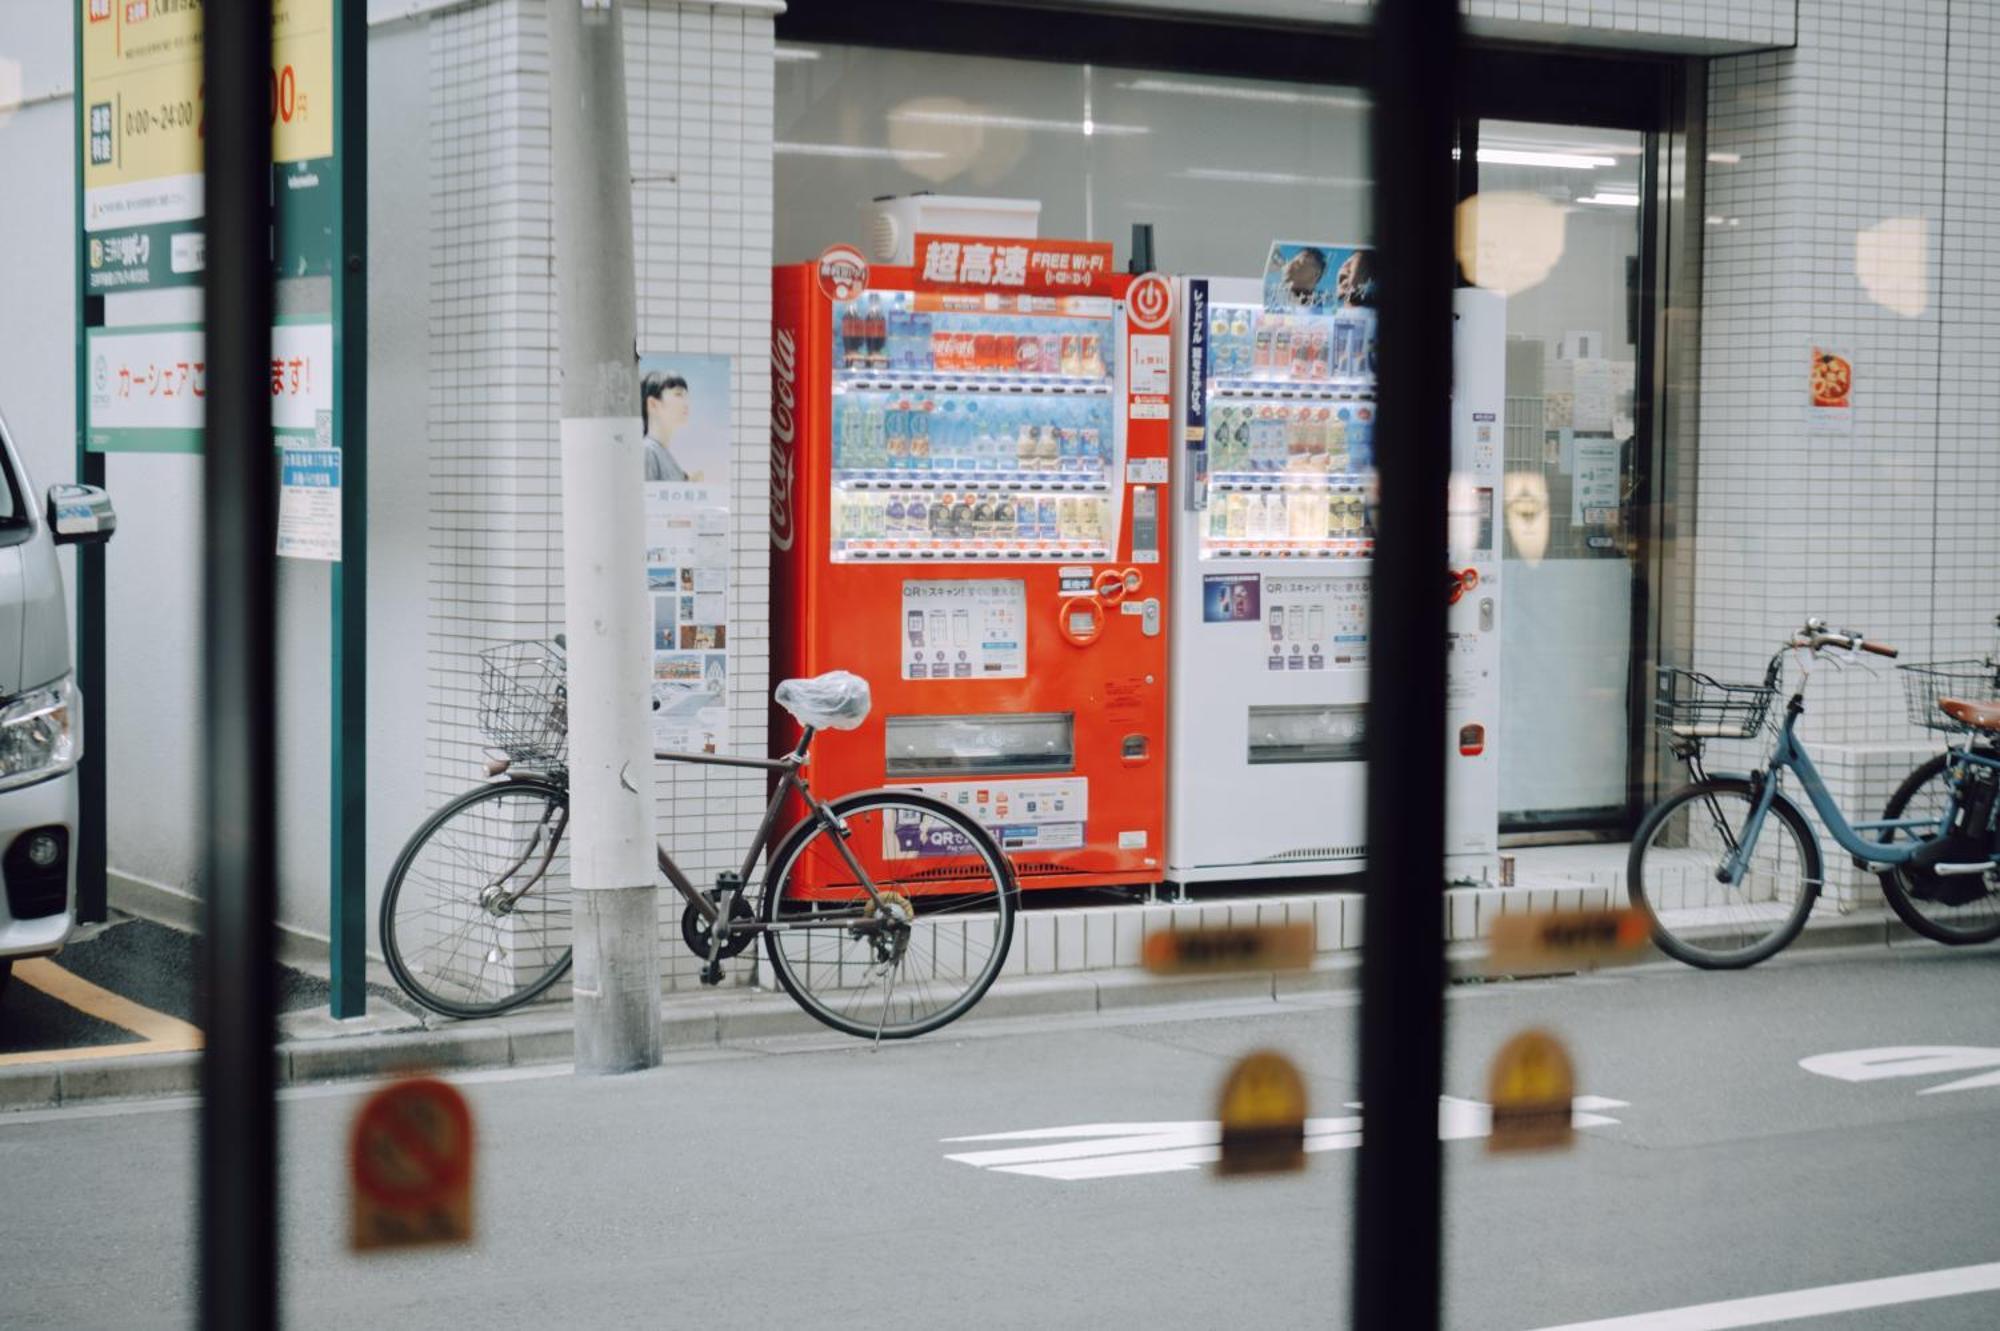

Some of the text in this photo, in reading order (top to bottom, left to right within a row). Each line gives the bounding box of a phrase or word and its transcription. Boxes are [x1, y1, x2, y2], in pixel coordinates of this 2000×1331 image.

[922, 241, 1029, 286] 超高速
[1031, 252, 1071, 270] FREE
